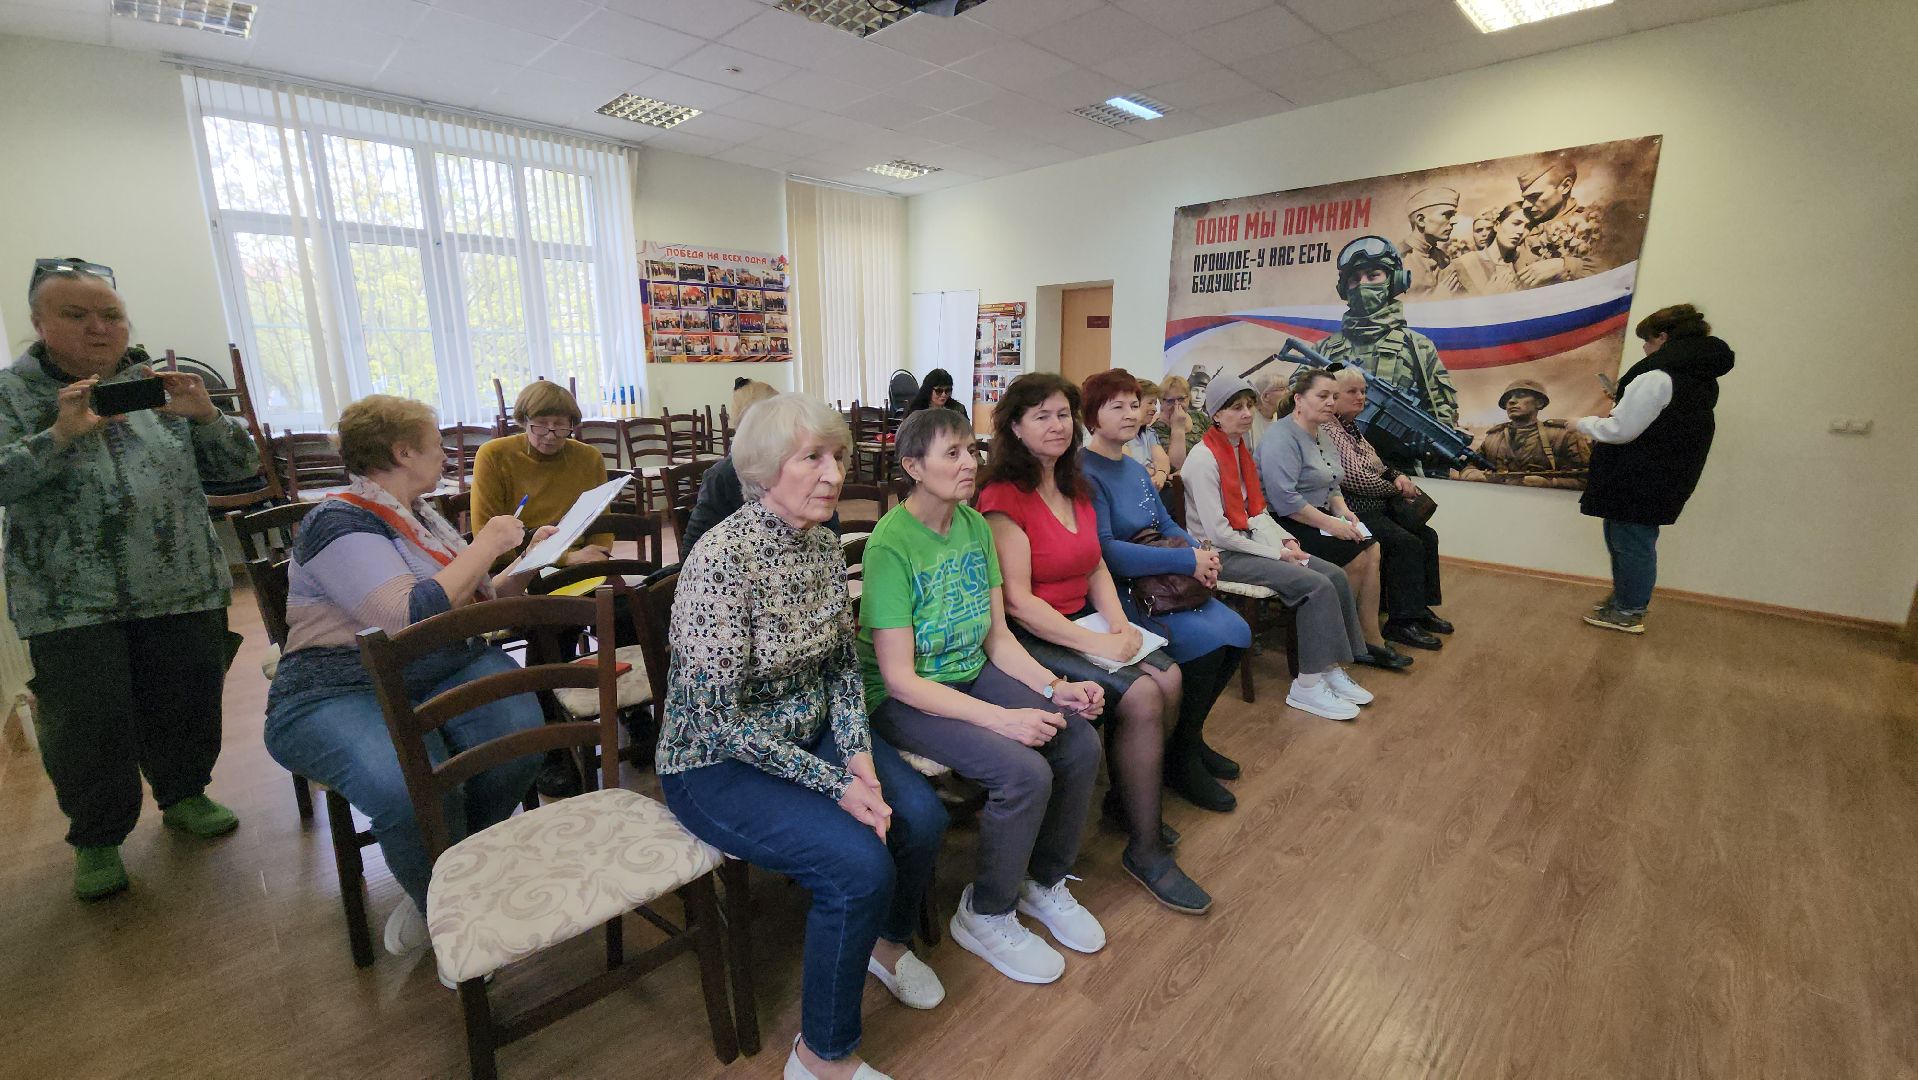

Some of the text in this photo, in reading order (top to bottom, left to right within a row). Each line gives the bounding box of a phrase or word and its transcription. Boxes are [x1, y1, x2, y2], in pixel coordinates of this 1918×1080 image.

[1196, 197, 1372, 245] ПОКА МЫ ПОМНИМ
[666, 248, 767, 265] ПОБЕДА НА ВСЕХ ОДНА
[1269, 246, 1296, 267] НАС
[1299, 243, 1331, 264] ЕСТЬ
[1192, 271, 1252, 293] БУДУЩЕЕ!
